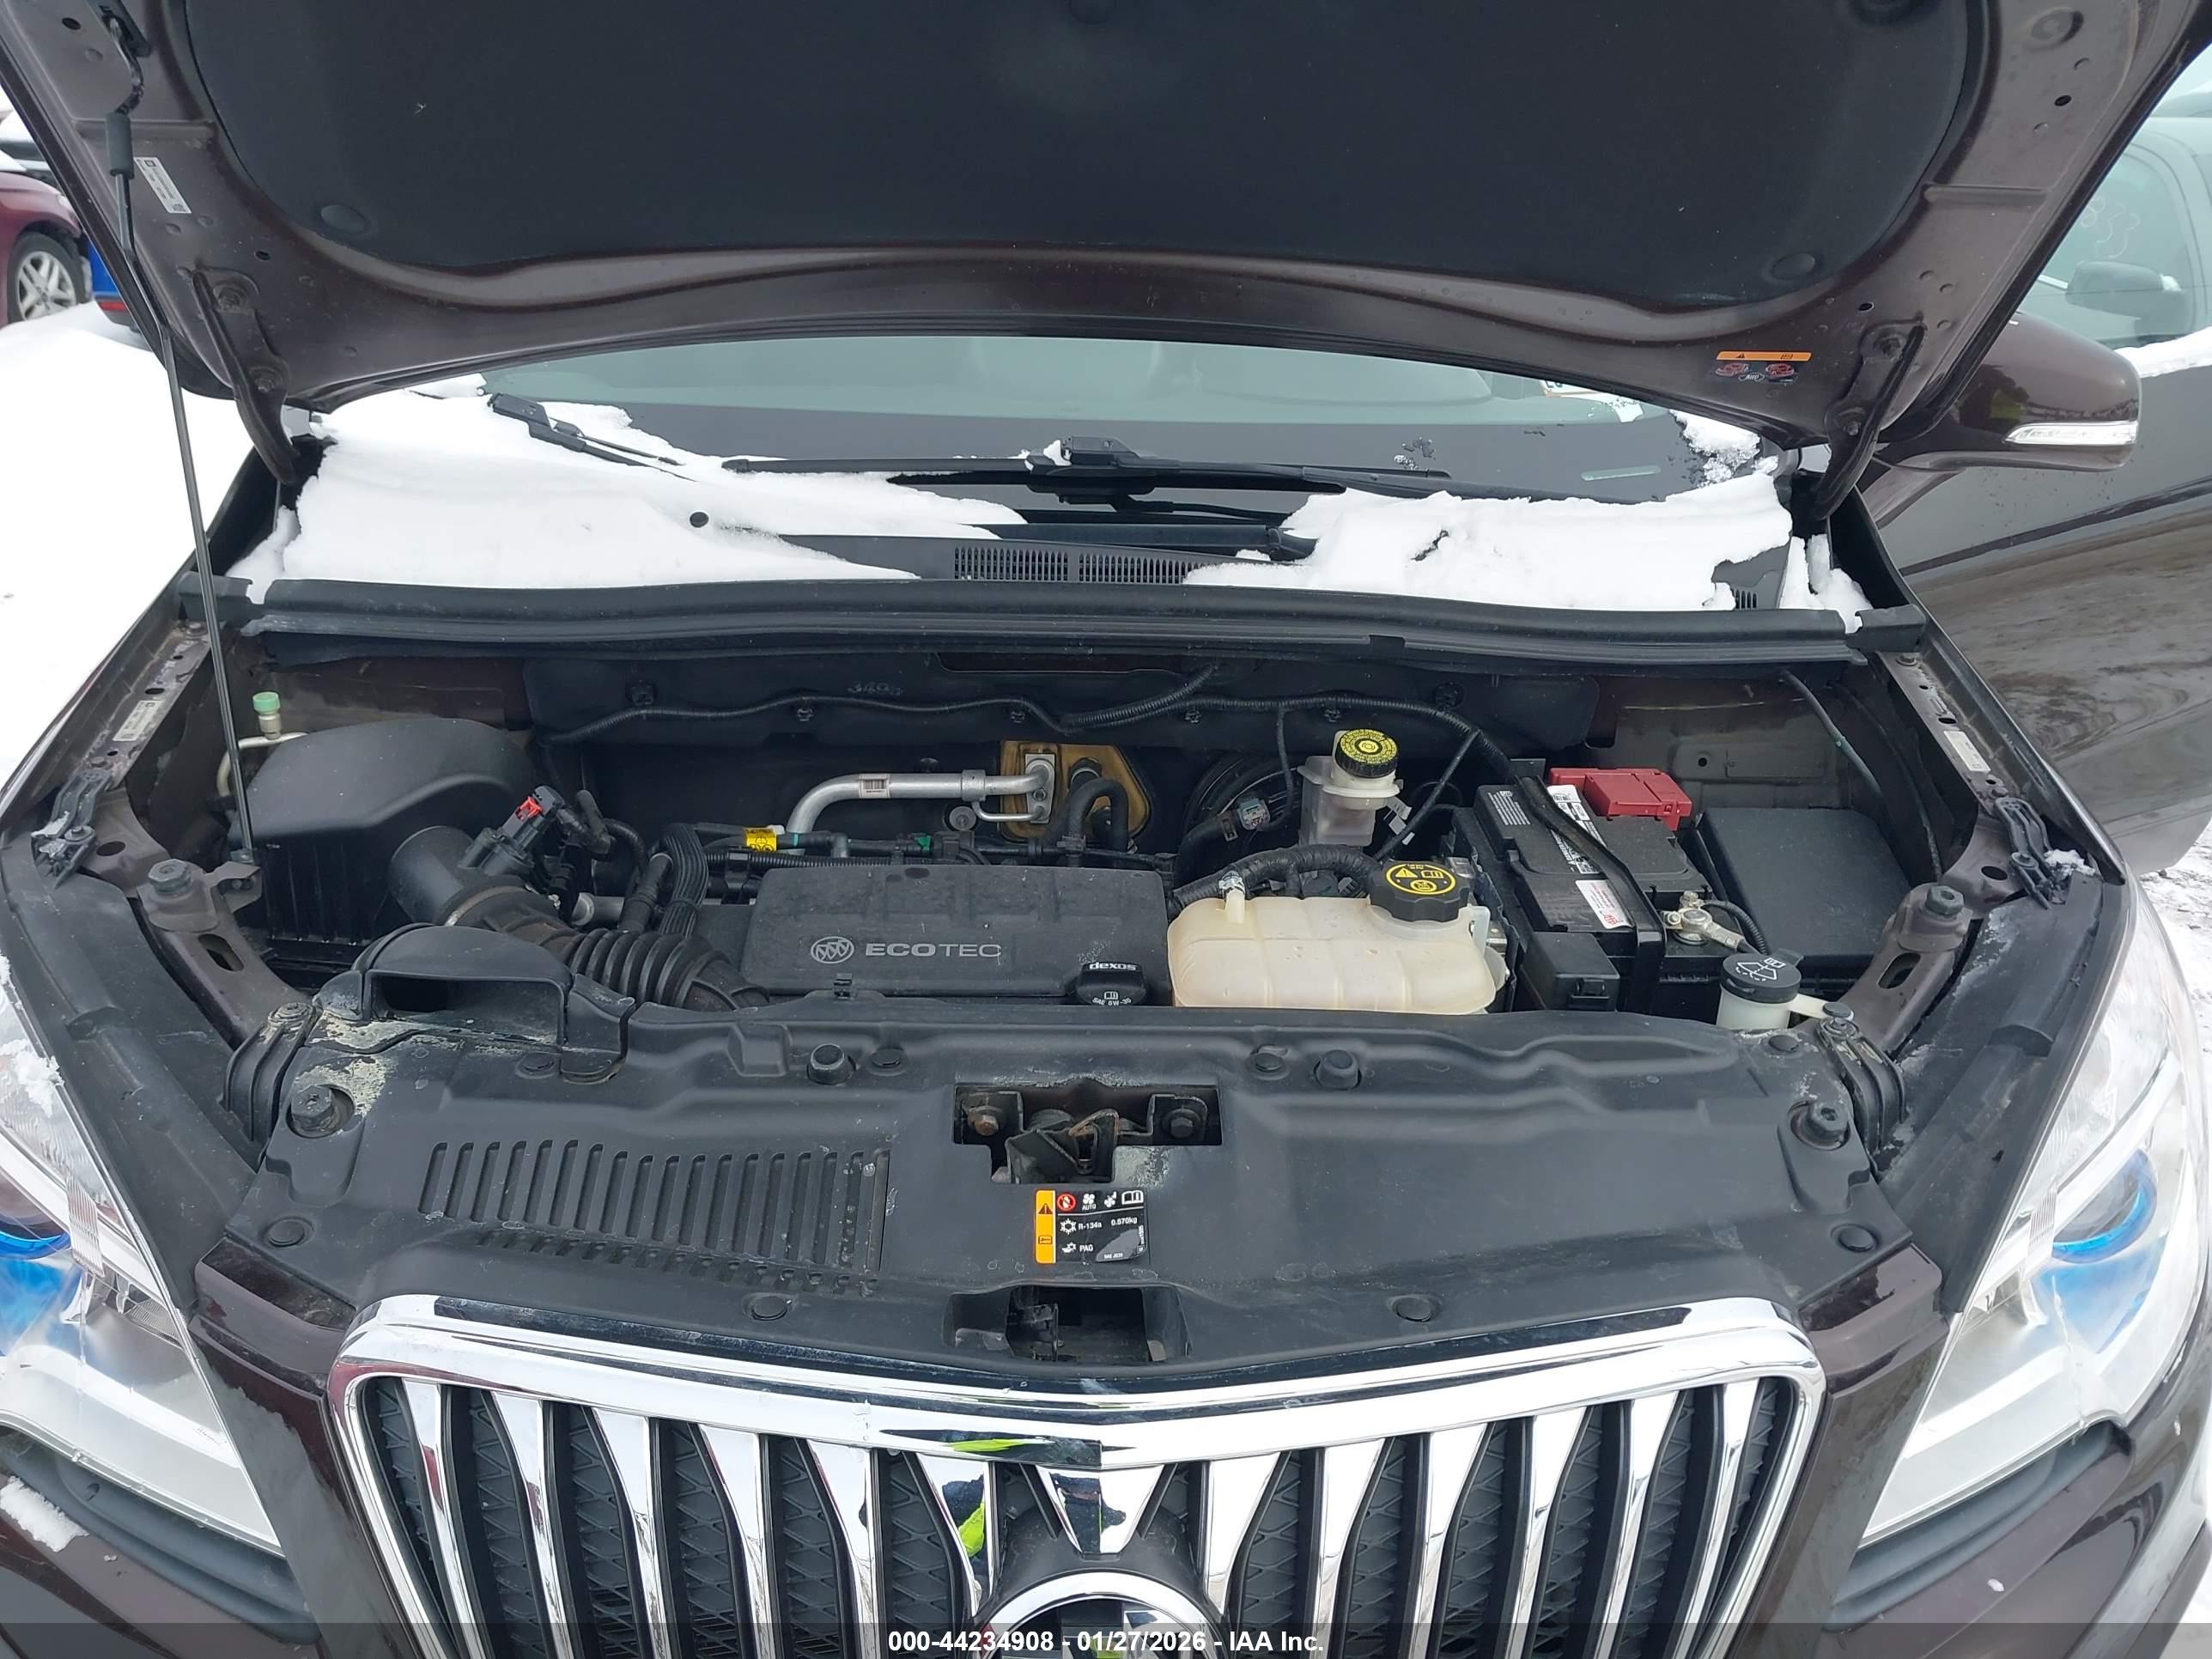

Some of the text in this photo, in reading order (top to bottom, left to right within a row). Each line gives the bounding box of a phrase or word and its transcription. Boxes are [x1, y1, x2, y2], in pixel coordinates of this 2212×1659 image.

[866, 943, 1002, 957] ECOTEC
[1089, 961, 1138, 971] dexos
[1092, 997, 1133, 1006] SAE 5W-30
[1078, 1220, 1103, 1231] R-134a
[1079, 1243, 1094, 1253] PAG
